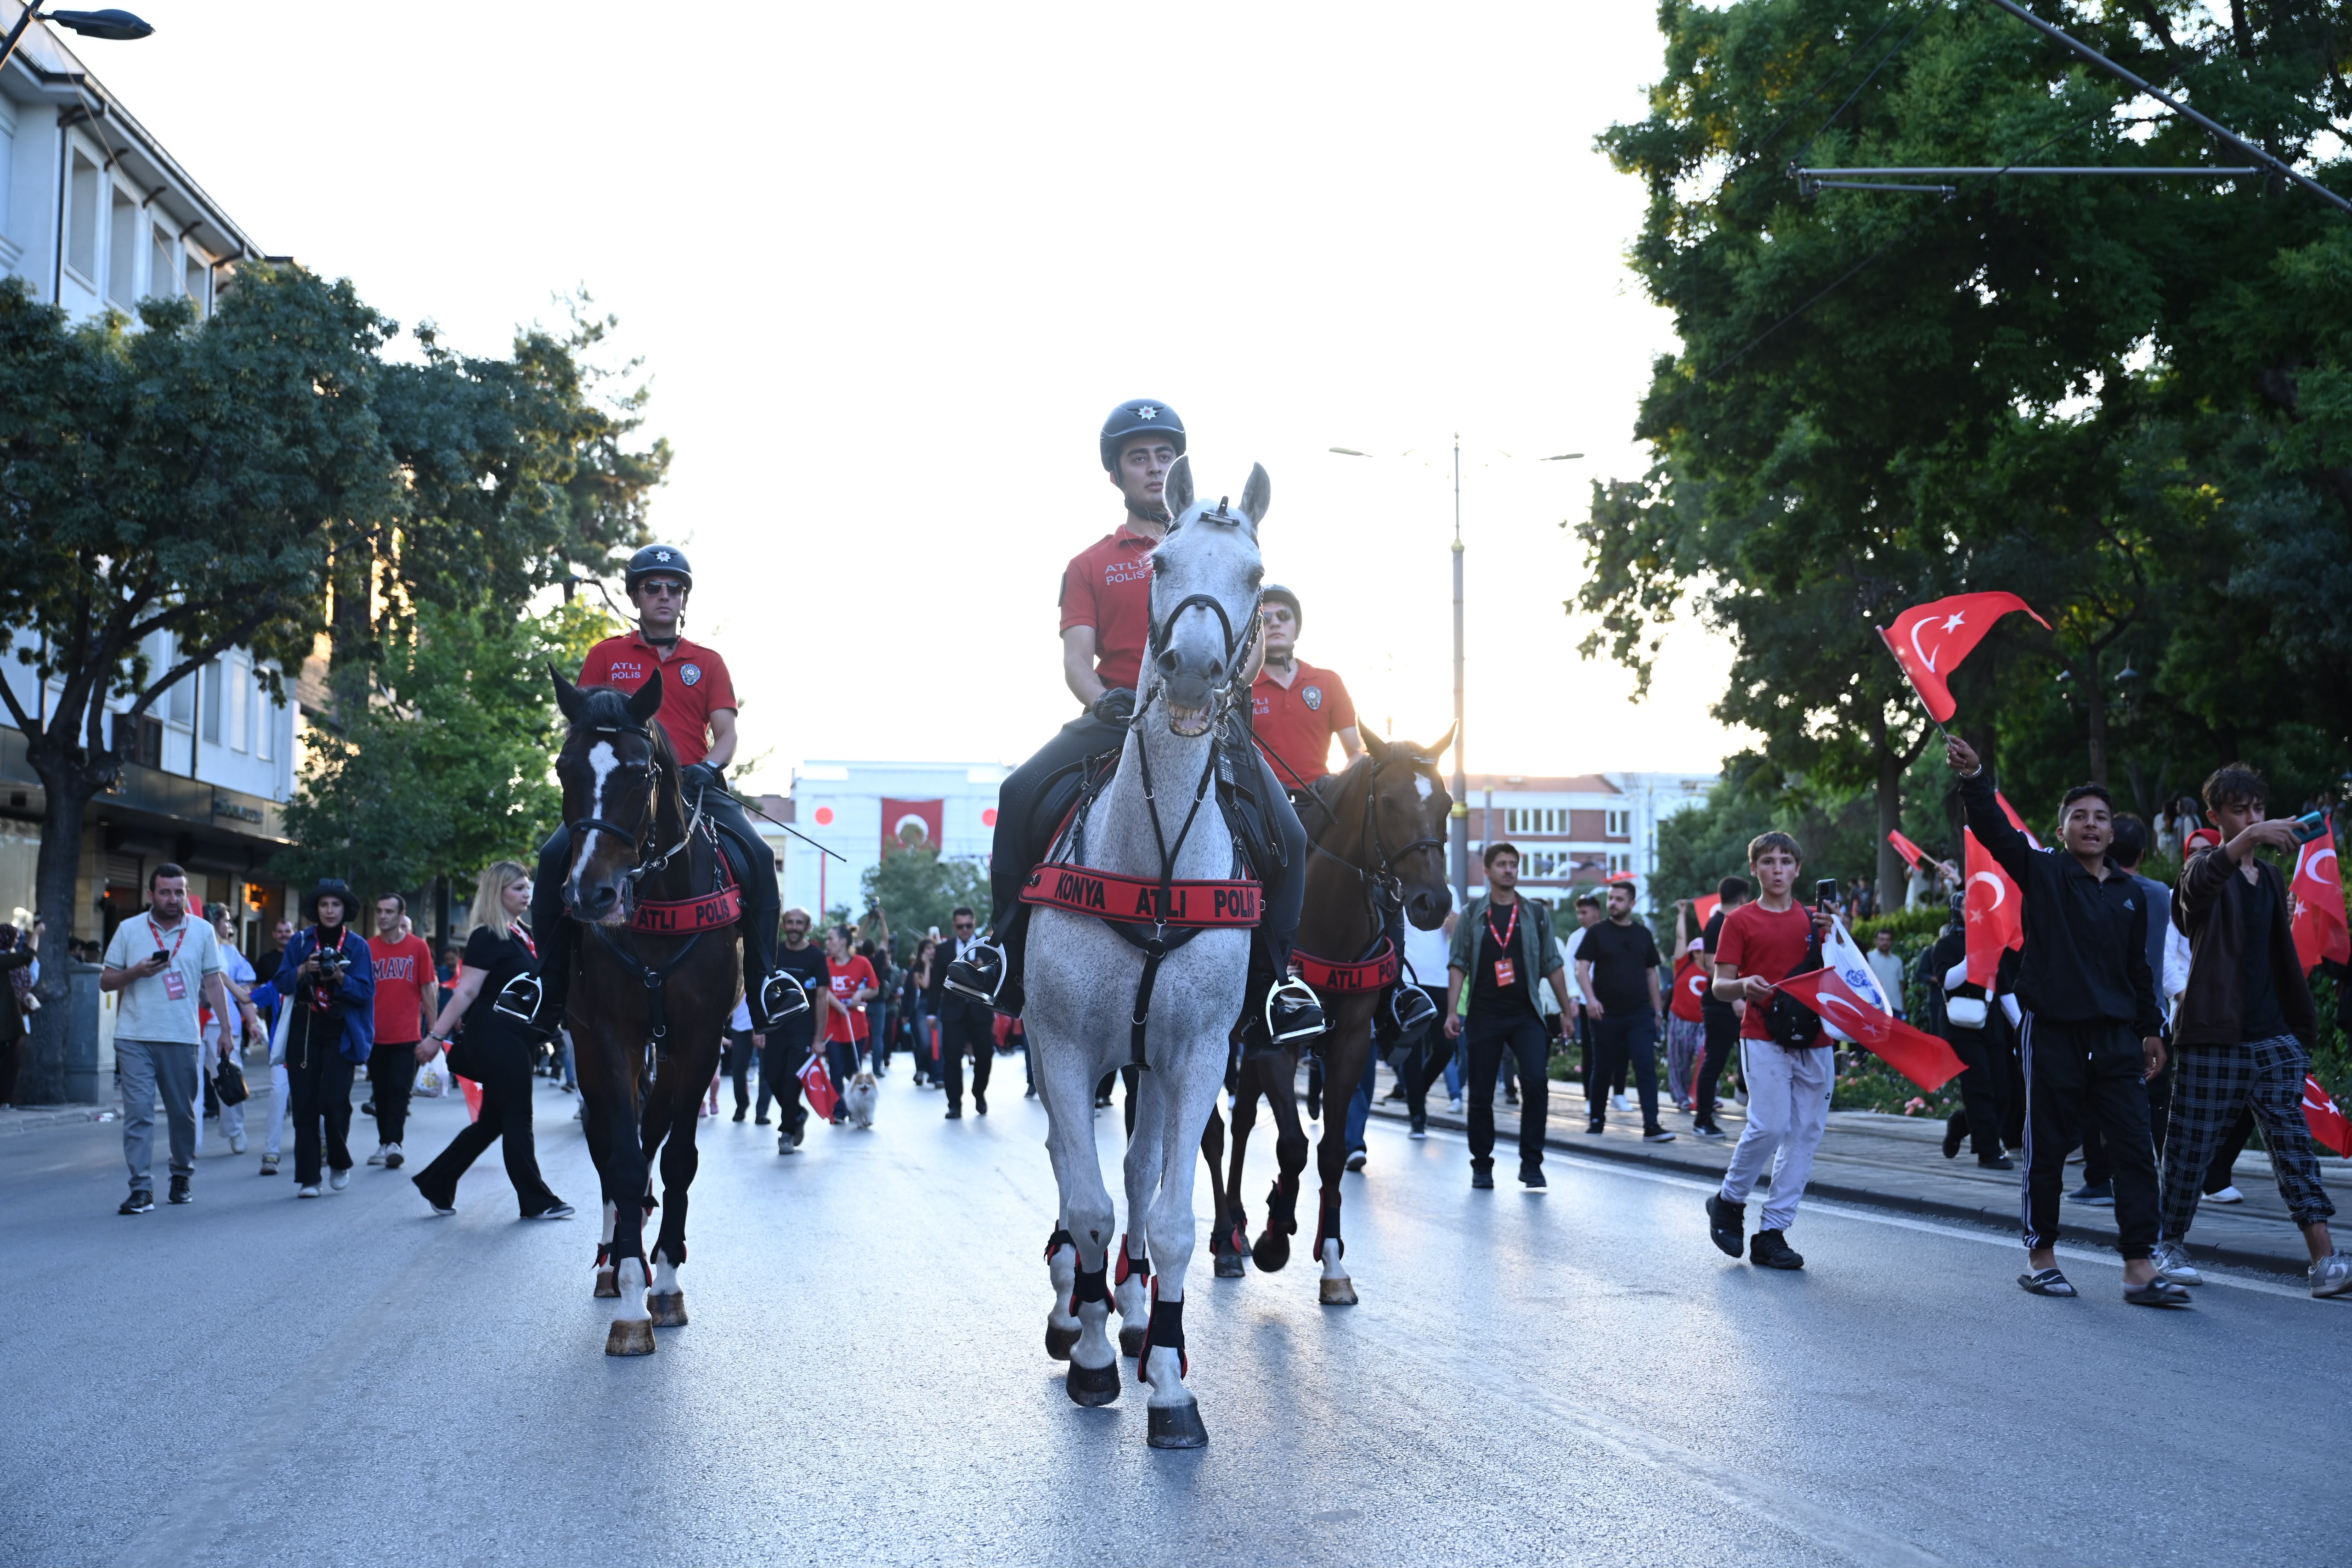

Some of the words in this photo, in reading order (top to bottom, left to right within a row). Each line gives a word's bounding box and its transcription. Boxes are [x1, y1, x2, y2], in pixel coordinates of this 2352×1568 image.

[1105, 561, 1143, 574] ATLI
[1054, 872, 1105, 909] KONYA
[637, 908, 676, 930] ATLI
[372, 955, 414, 982] MAVİ
[1326, 969, 1363, 987] ATLI
